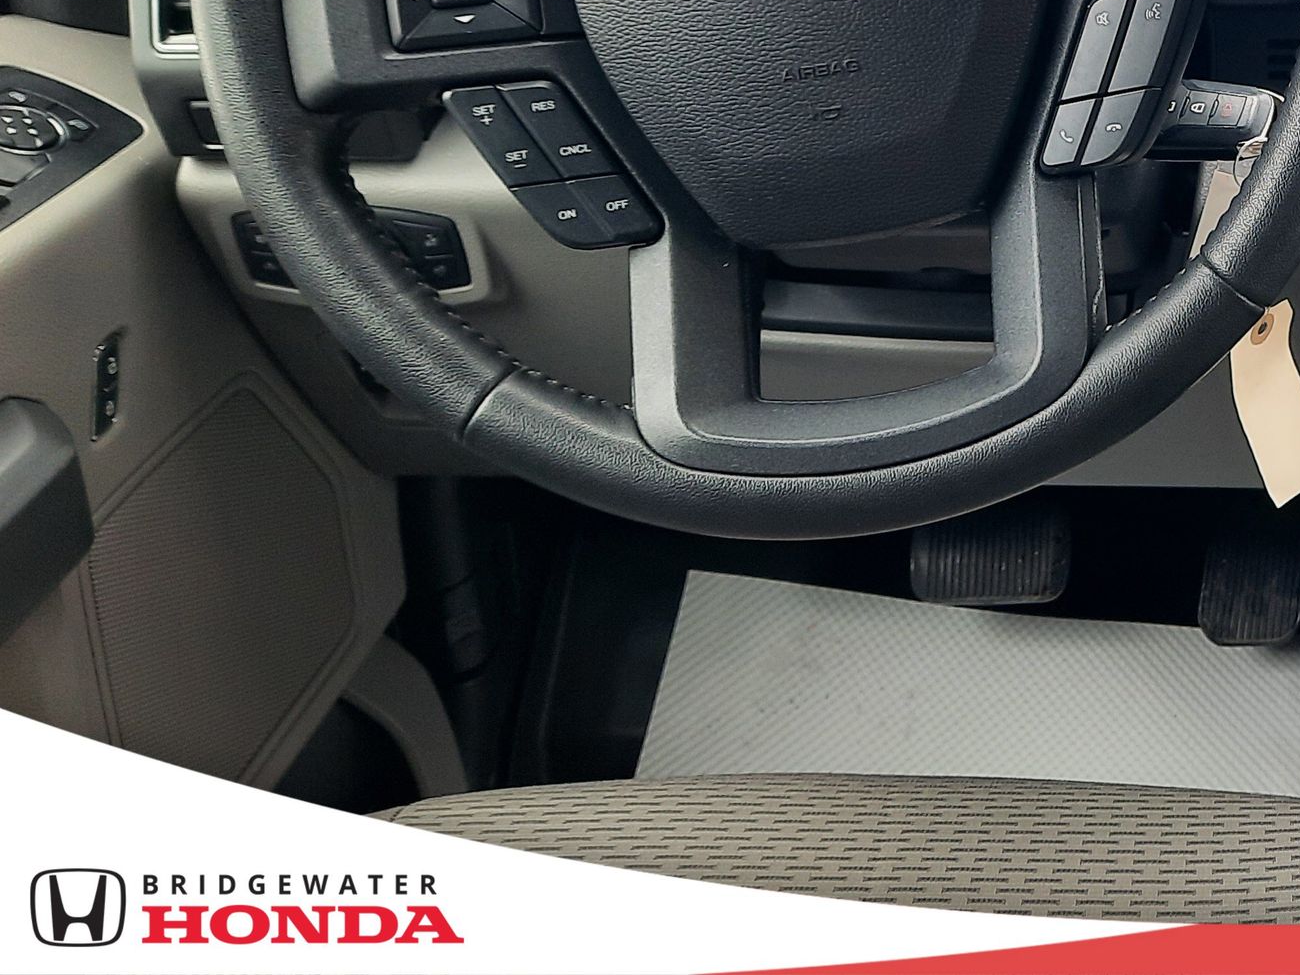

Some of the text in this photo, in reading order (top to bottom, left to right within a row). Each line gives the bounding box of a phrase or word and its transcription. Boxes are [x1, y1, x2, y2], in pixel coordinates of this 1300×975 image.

[472, 103, 496, 116] SET
[530, 100, 556, 113] RES
[505, 149, 529, 162] SET
[558, 143, 592, 156] CNCL
[605, 199, 630, 212] OFF
[558, 208, 577, 221] ON
